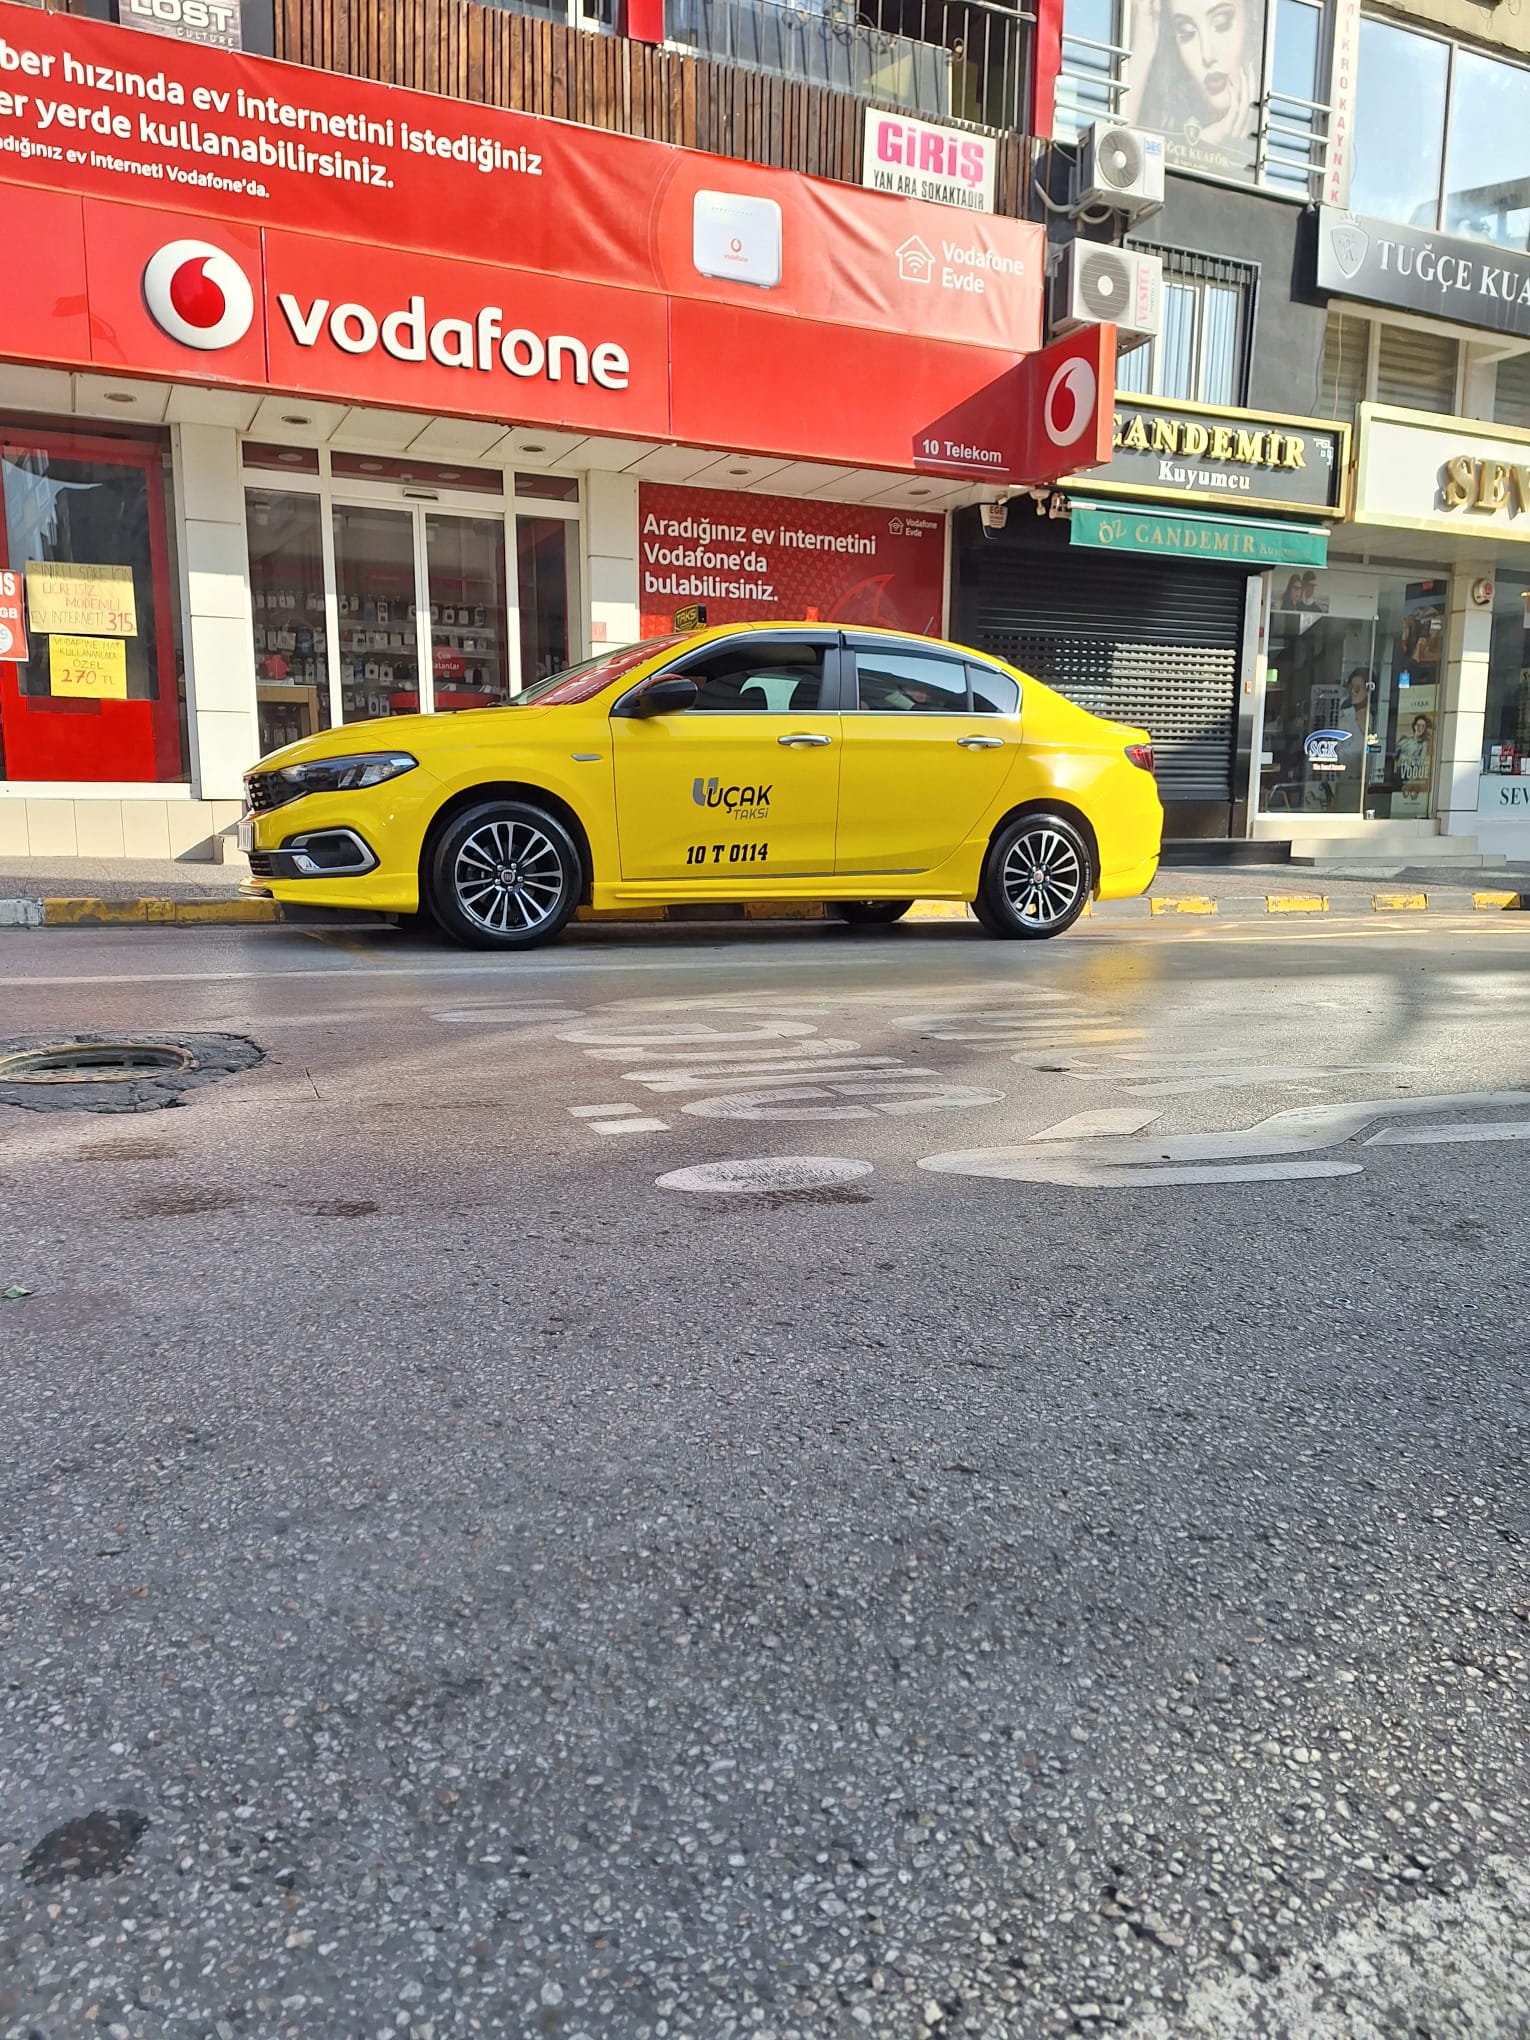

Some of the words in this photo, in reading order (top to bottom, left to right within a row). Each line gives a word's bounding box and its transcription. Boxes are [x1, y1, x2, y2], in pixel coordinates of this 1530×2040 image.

[130, 0, 232, 32] LOST
[177, 27, 235, 47] CULTURE
[63, 50, 185, 106] hızında
[192, 87, 231, 113] ev
[237, 89, 394, 148] internetini
[401, 123, 543, 176] istediğiniz
[35, 98, 132, 139] yerde
[139, 113, 394, 188] kullanabilirsiniz.
[0, 134, 63, 160] dığınız
[66, 149, 88, 164] ev
[166, 165, 270, 198] Vodafone'da.
[874, 169, 893, 191] YAN
[897, 175, 917, 196] ARA
[921, 180, 985, 211] SOKAKTADIR
[941, 240, 1025, 275] Vodafone
[1376, 240, 1473, 293] TUĞÇE
[942, 267, 985, 293] Evde
[277, 293, 630, 389] vodafone
[923, 439, 939, 455] 10
[944, 441, 1002, 463] Telekom
[1158, 460, 1250, 489] Kuyumcu
[643, 513, 747, 545] Aradığınız
[751, 528, 776, 545] ev
[779, 526, 877, 555] internetini
[905, 518, 938, 529] Vodafone
[905, 527, 923, 537] Evde
[1098, 518, 1127, 544] ÖZ
[1135, 524, 1256, 553] CANDEMİR
[644, 571, 779, 601] bulabilirsiniz.
[61, 668, 97, 685] 270
[434, 662, 460, 670] atanlar
[1309, 740, 1338, 758] SGK
[705, 784, 774, 814] UÇAK
[686, 845, 707, 865] 10
[712, 844, 726, 863] T
[729, 843, 769, 863] 0114
